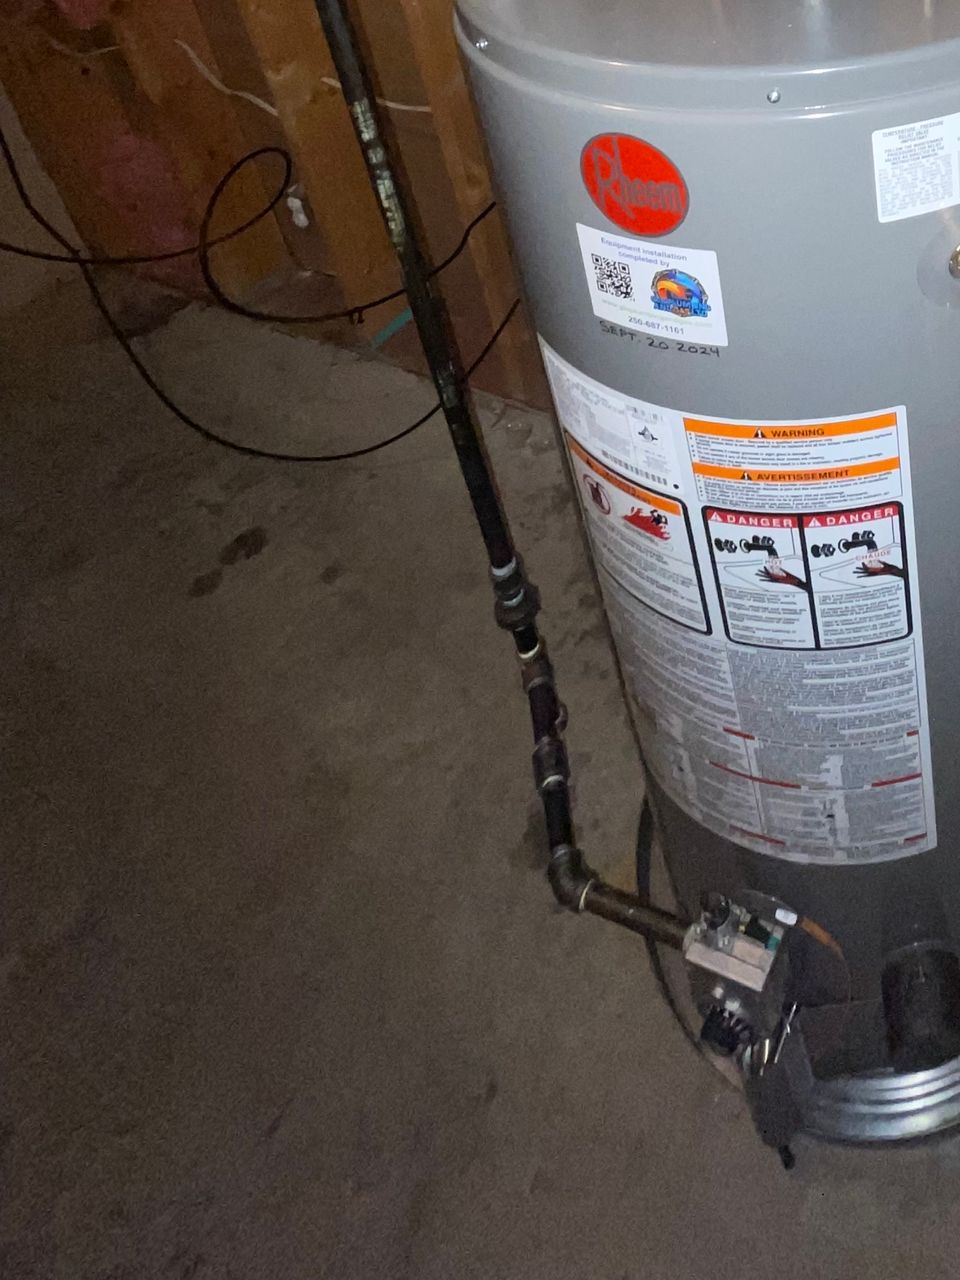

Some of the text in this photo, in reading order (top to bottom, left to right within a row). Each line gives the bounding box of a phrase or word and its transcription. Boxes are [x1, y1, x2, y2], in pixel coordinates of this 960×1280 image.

[591, 134, 682, 221] Rheem
[647, 337, 669, 350] 20
[676, 342, 720, 357] 2024
[770, 428, 825, 439] WARNING
[757, 469, 850, 482] AVERTISSEMENT
[726, 514, 793, 527] DANGER
[826, 508, 894, 525] DANGER
